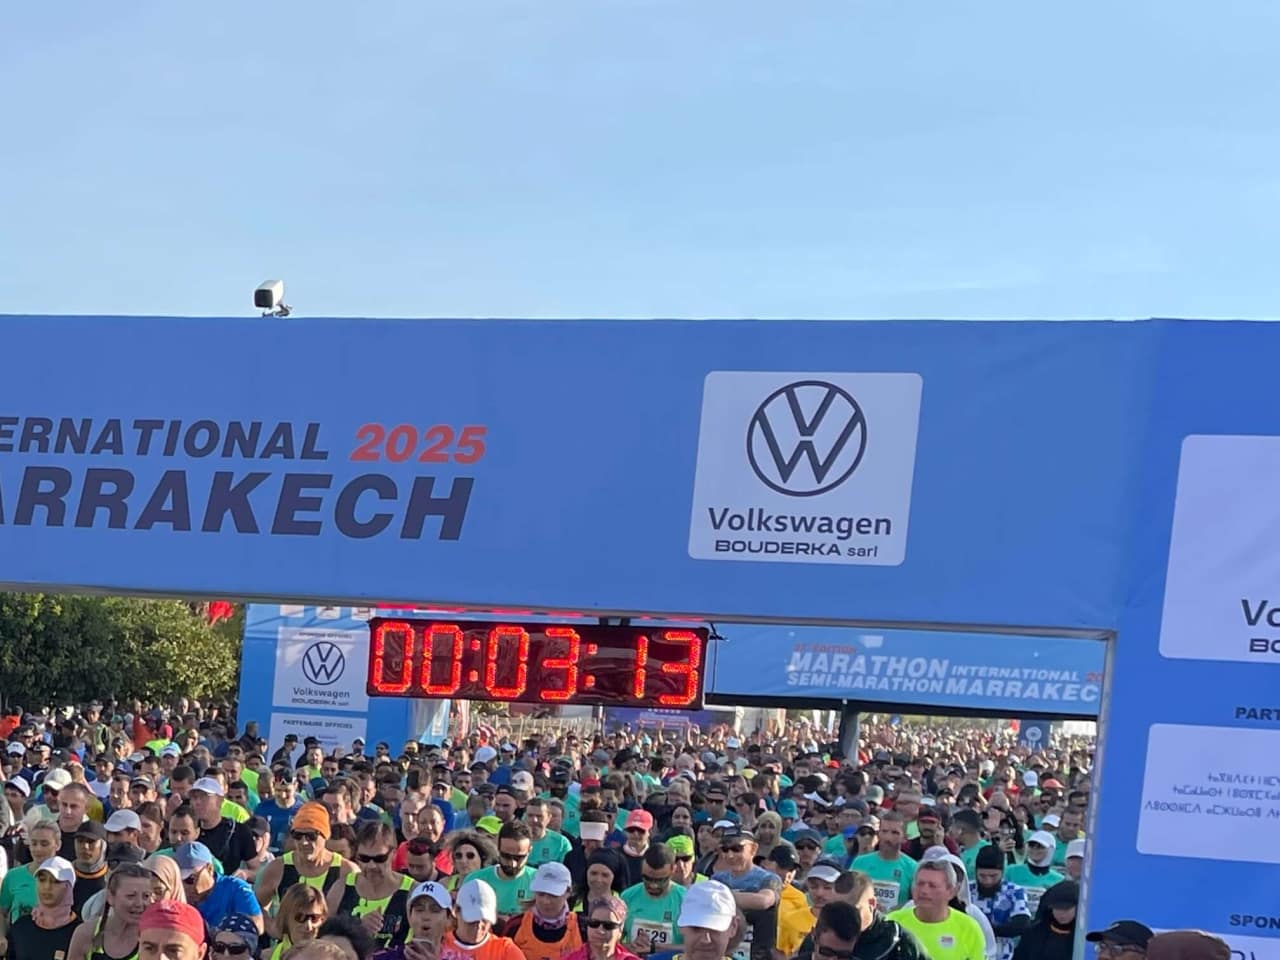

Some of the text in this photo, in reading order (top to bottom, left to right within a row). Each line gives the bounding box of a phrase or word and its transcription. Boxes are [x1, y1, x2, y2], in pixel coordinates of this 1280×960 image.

[349, 423, 489, 464] 2025
[708, 507, 892, 541] Volkswagen
[715, 540, 878, 558] BOUDERKA sarl
[373, 621, 701, 705] 00:03:13
[788, 651, 950, 679] MARATHON
[951, 665, 1080, 682] INTERNATIONAL
[293, 687, 351, 698] Volkswagen
[787, 672, 944, 694] SEMI-MARATHON
